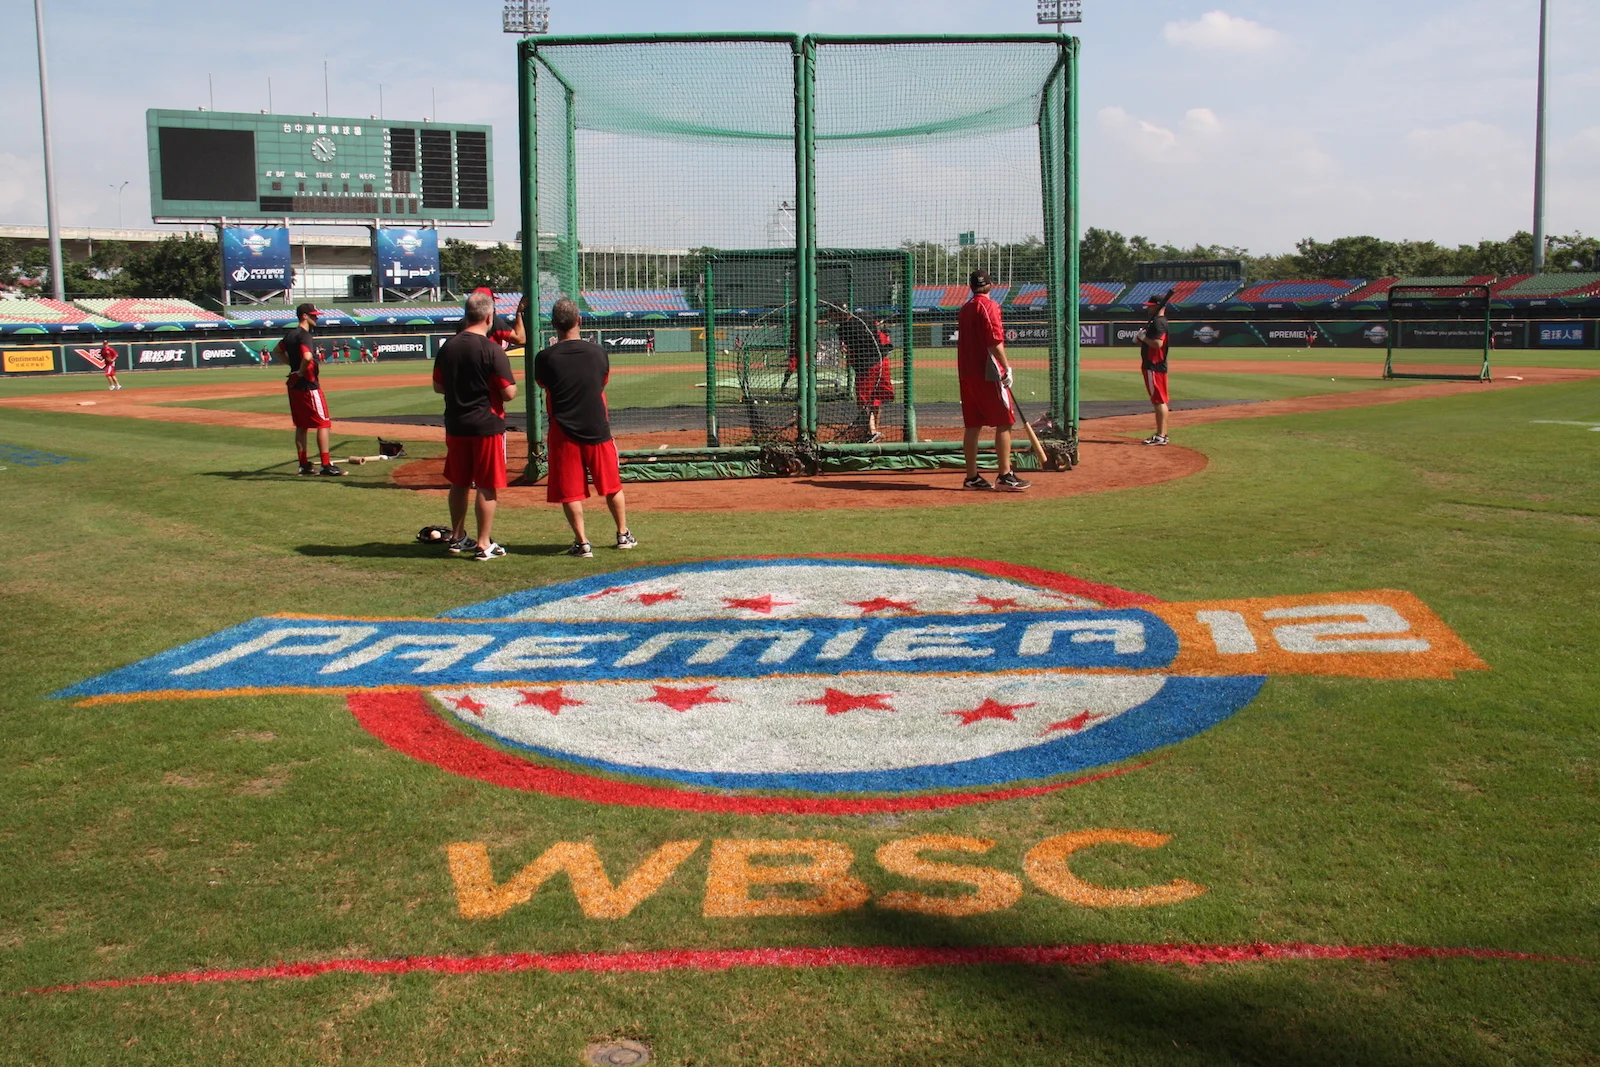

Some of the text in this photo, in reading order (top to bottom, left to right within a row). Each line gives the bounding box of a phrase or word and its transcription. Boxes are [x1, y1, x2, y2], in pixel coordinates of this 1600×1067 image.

[8, 356, 44, 364] Continental
[140, 349, 186, 363] 黑松沙士
[202, 349, 236, 360] @WBSC
[169, 602, 1430, 675] PREMIER 12
[447, 829, 1208, 920] WBSC
